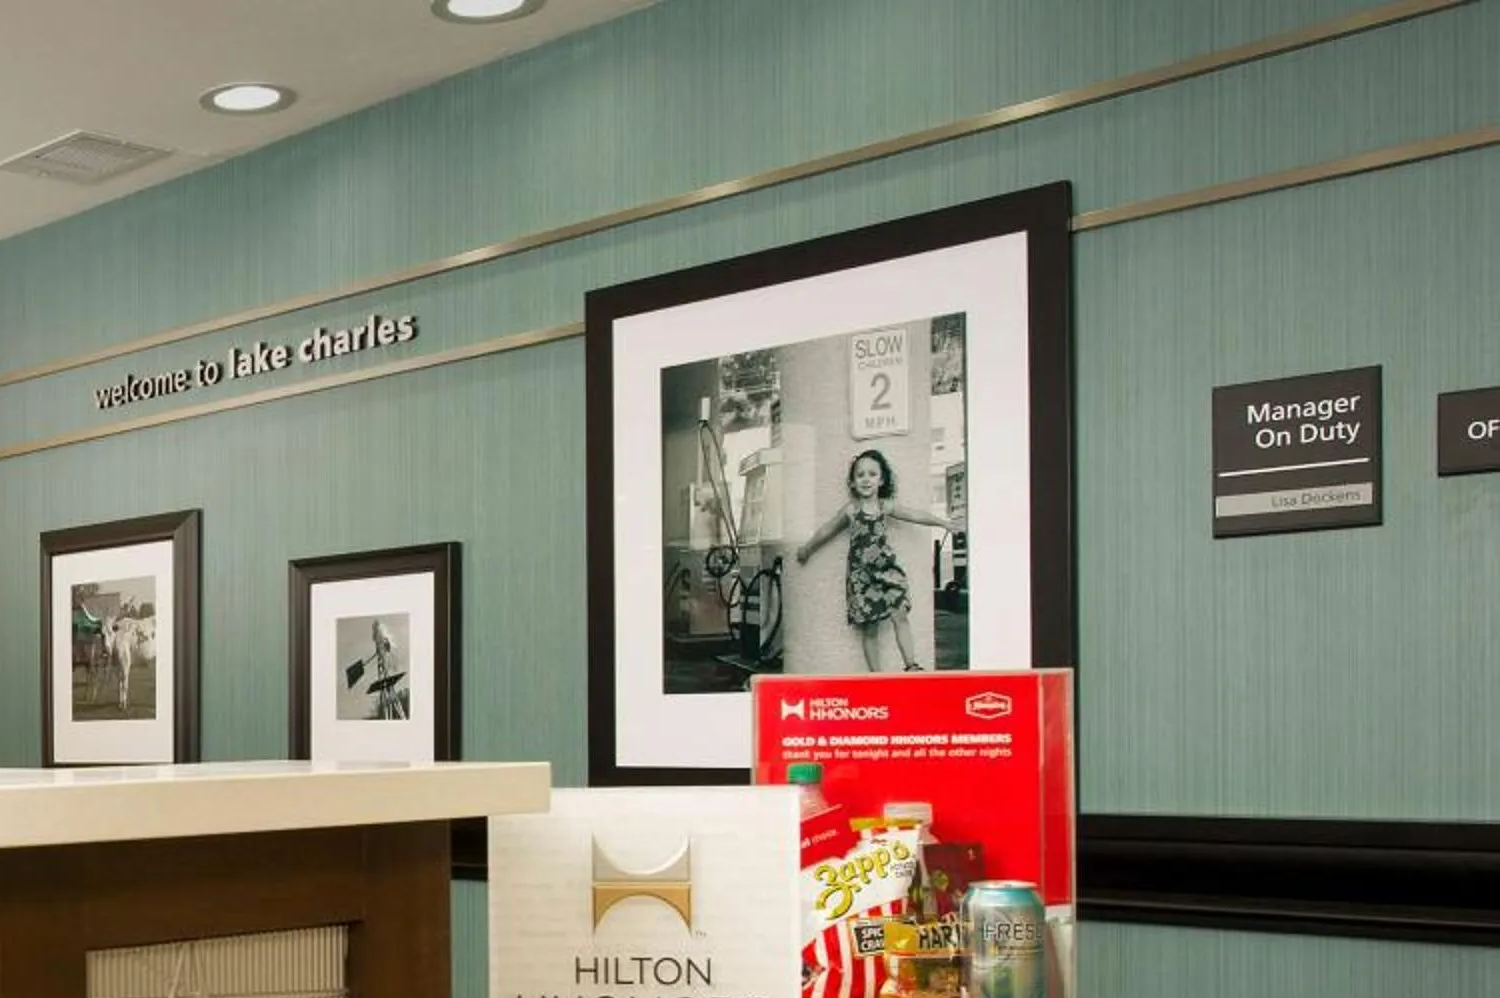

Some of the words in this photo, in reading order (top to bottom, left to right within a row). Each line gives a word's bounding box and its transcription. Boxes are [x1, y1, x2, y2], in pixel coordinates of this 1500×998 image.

[92, 369, 190, 409] welcome
[196, 361, 225, 386] to
[228, 342, 292, 379] lake
[299, 313, 419, 362] charles
[855, 335, 902, 359] SLOW
[870, 372, 892, 410] 2
[1247, 395, 1361, 424] Manager
[1255, 428, 1291, 449] On
[1300, 421, 1361, 445] Duty
[809, 698, 848, 707] HILTON
[809, 706, 889, 720] HHONORS
[782, 736, 816, 747] GOLD
[829, 735, 889, 746] DIAMOND
[890, 734, 949, 745] HHONORS
[951, 733, 1012, 745] MEMBERS
[575, 956, 712, 986] HILTON
